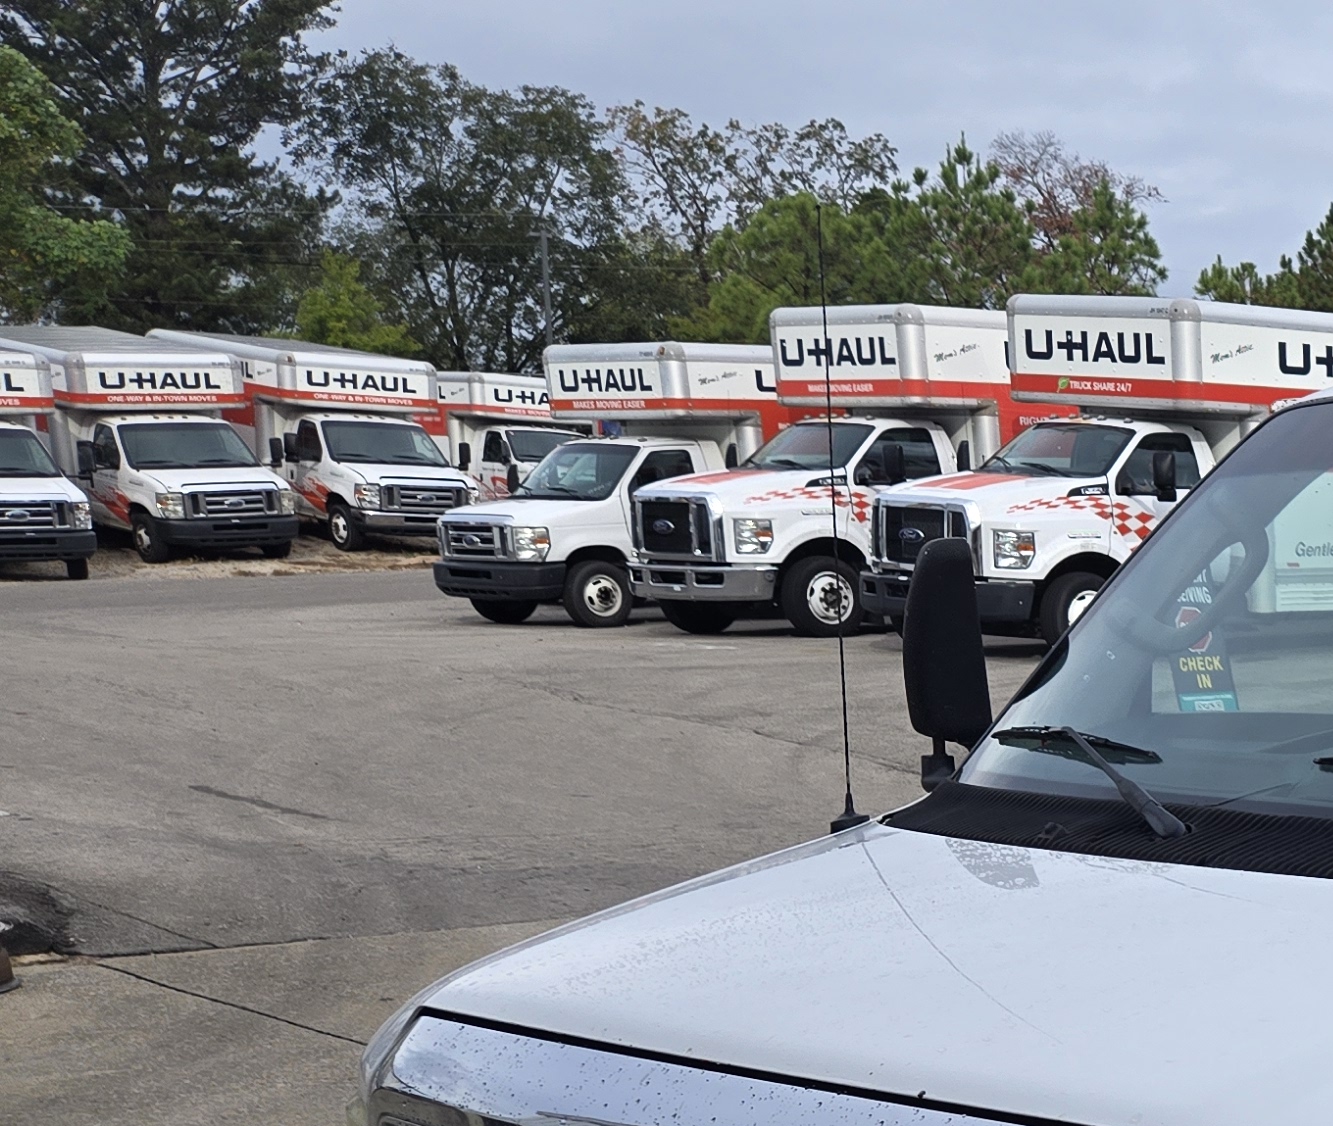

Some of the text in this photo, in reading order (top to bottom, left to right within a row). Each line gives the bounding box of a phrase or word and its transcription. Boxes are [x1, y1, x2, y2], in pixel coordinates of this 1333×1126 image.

[779, 336, 897, 367] U-HAUL
[1025, 329, 1165, 365] U-HAUL
[98, 371, 221, 390] U-HAUL
[306, 370, 417, 394] U-HAUL
[559, 368, 653, 392] U-HAUL
[1069, 380, 1132, 392] TRUCK SHARE 24/7
[494, 388, 550, 405] U-HA
[1179, 655, 1224, 672] CHECK
[1196, 673, 1212, 689] IN
